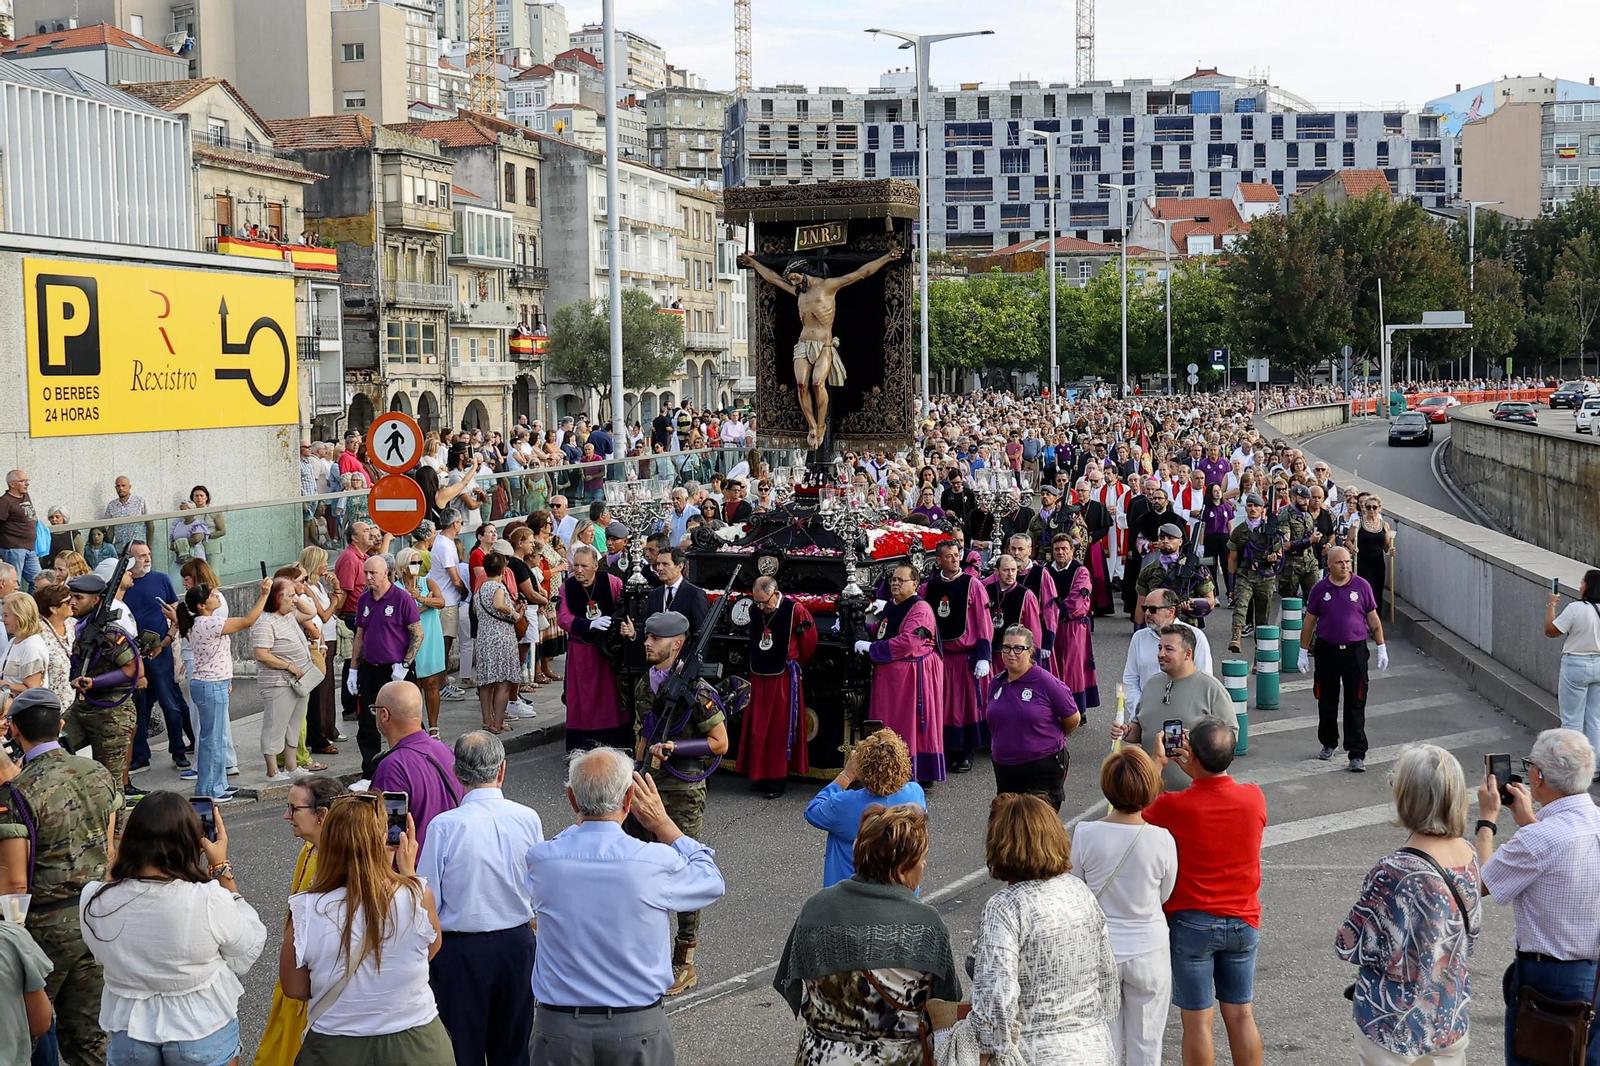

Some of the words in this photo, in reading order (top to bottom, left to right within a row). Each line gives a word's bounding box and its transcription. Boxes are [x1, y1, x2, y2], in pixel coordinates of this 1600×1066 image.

[45, 284, 90, 366] P
[1214, 350, 1222, 361] P
[130, 359, 197, 392] Rexistro
[42, 386, 52, 401] O
[54, 386, 100, 401] BERBES
[45, 408, 58, 422] 24
[60, 406, 100, 422] HORAS
